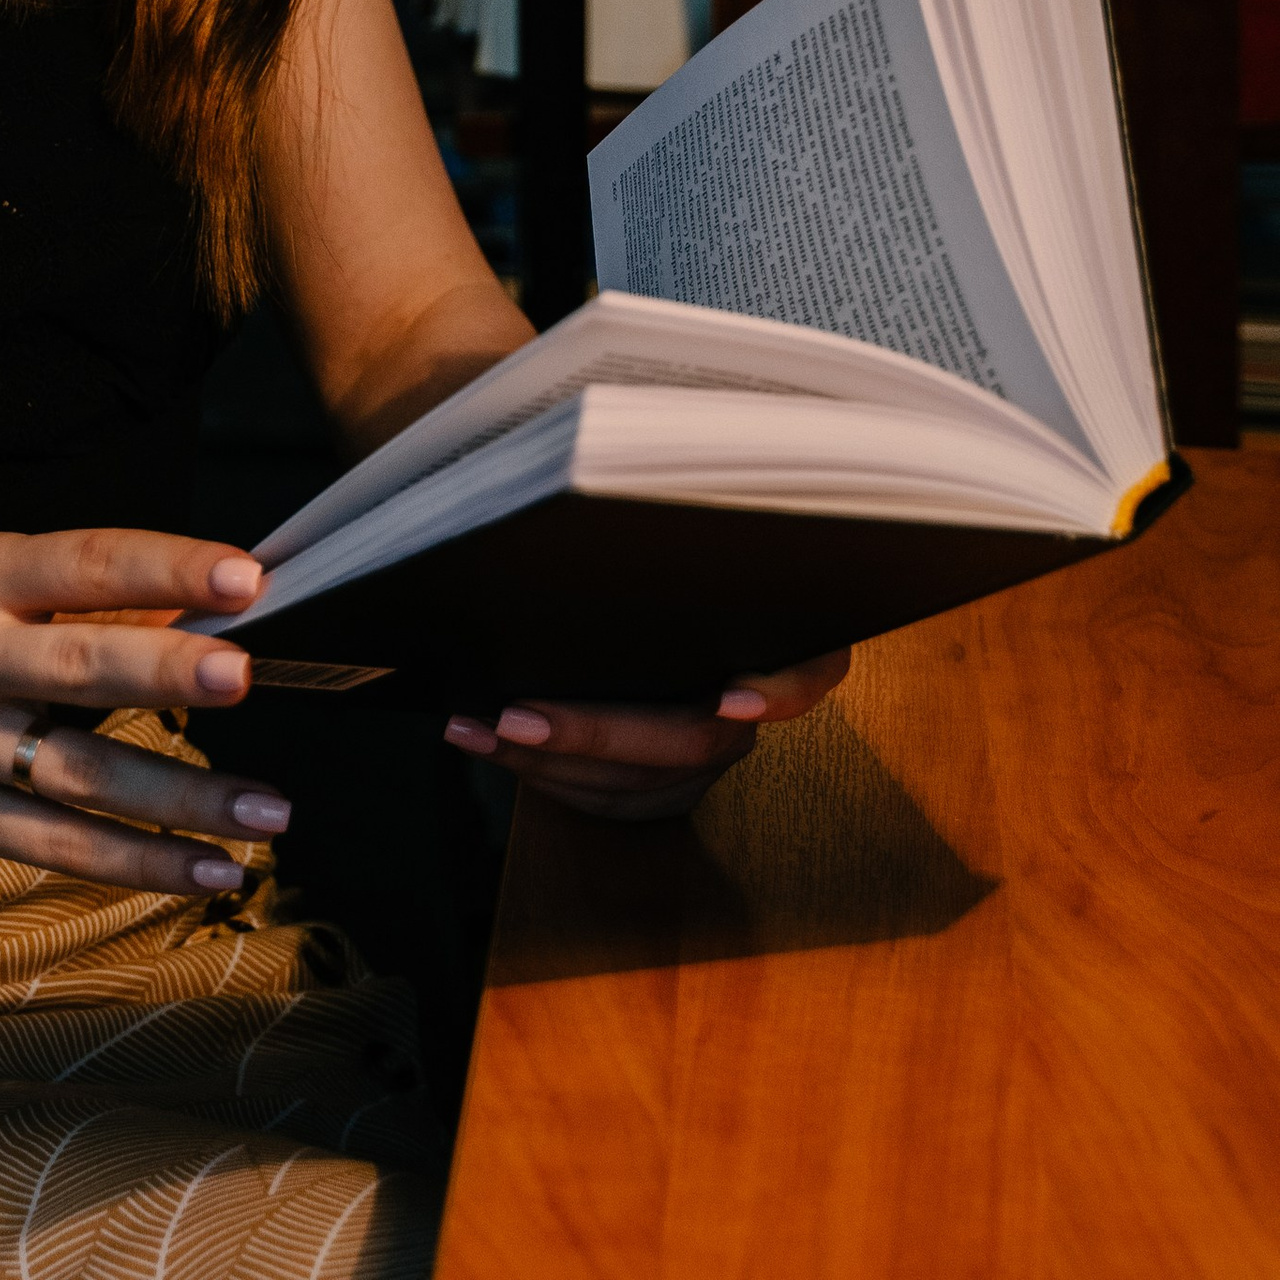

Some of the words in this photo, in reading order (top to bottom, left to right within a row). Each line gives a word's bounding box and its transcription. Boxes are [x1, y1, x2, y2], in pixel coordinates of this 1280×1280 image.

[739, 74, 751, 132] смертия
[775, 75, 790, 128] Делезу,
[784, 64, 806, 158] Повторимся,
[687, 113, 698, 184] этические
[694, 110, 704, 166] Алексея
[661, 136, 674, 238] прерывностью
[675, 152, 689, 237] пропускает)
[701, 102, 713, 171] Еременко
[713, 206, 729, 294] виртуозного
[715, 156, 727, 214] отличие
[741, 157, 758, 231] Владимир
[721, 145, 736, 218] (подобная
[731, 221, 753, 307] физической
[742, 219, 758, 288] особенно
[834, 248, 854, 303] текстах
